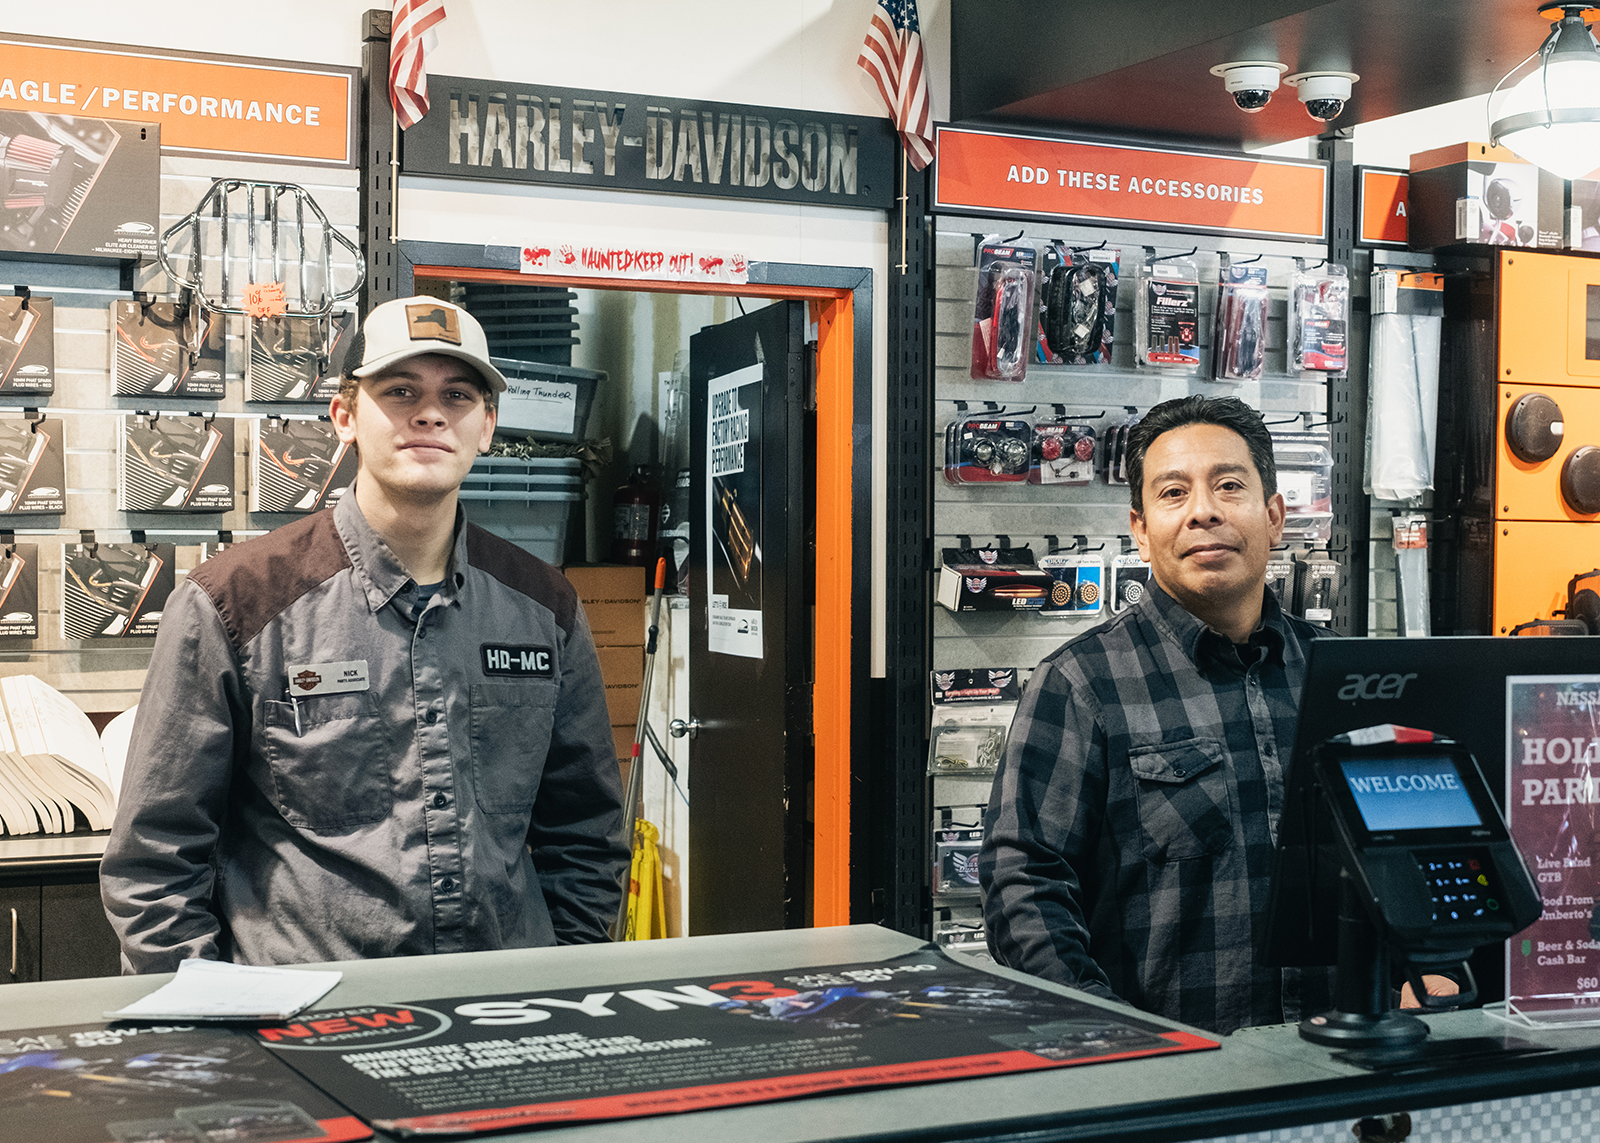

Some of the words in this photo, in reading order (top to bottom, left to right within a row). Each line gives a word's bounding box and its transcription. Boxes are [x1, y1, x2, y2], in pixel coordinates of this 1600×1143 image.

[448, 88, 859, 195] HARLEY-DAVIDSON
[1007, 164, 1049, 185] ADD
[1057, 169, 1120, 193] THESE
[1127, 175, 1265, 205] ACCESSORIES
[669, 252, 694, 275] OUT!
[508, 385, 531, 400] Rolling
[967, 422, 999, 430] PROBEAM
[1337, 672, 1418, 700] acer
[1349, 773, 1459, 794] WELCOME
[1537, 858, 1562, 869] Live
[1537, 872, 1562, 883] GTB
[1542, 896, 1563, 906] ood
[1565, 896, 1594, 906] From
[1537, 941, 1562, 952] Beer
[1564, 941, 1574, 950] &
[1537, 956, 1564, 966] Cash
[1567, 954, 1586, 964] Bar
[1576, 977, 1598, 990] $60
[454, 979, 800, 1026] SYN3
[258, 1010, 415, 1042] NEW
